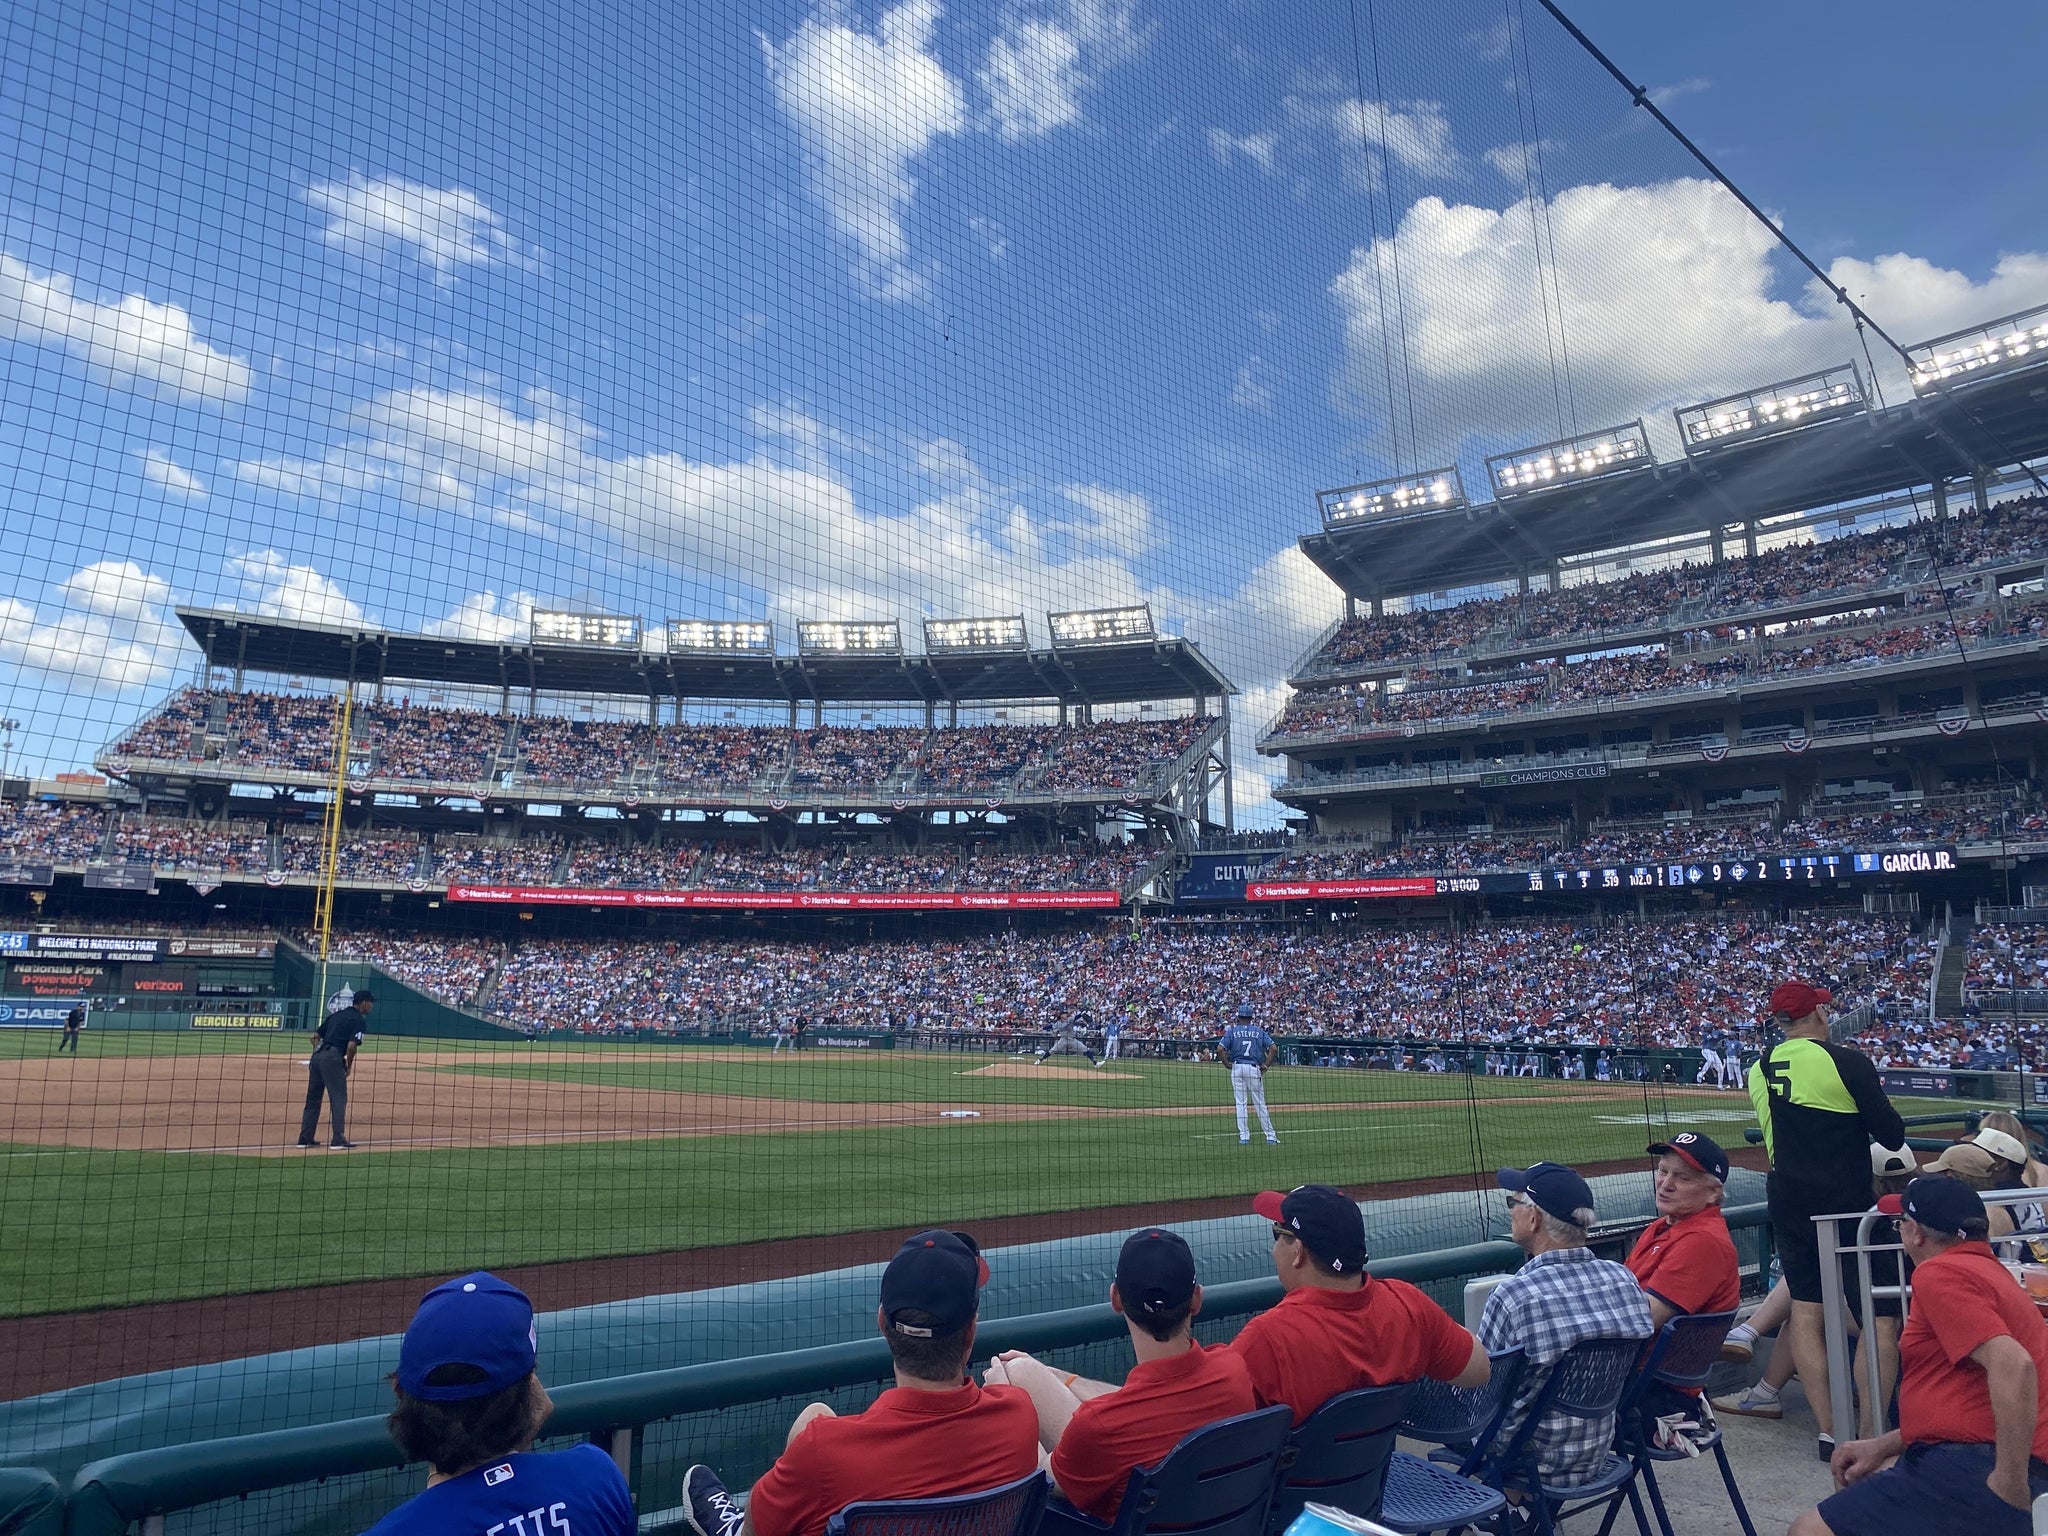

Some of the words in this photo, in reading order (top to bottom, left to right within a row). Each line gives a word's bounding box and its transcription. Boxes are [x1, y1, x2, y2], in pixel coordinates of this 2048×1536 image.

[1510, 769, 1574, 783] CHAMPIONS
[1577, 766, 1607, 778] CLUB
[1882, 850, 1932, 872] GARCÍA
[1934, 851, 1956, 869] JR.
[1713, 865, 1721, 881] 9
[1759, 862, 1766, 878] 2
[1786, 867, 1792, 879] 3
[1806, 866, 1813, 878] 2
[1829, 865, 1834, 877] 1
[1436, 880, 1447, 892] 29
[1450, 879, 1479, 891] WOOD
[1529, 880, 1542, 890] .121
[1559, 879, 1563, 888] 1
[1581, 878, 1587, 888] 3
[1602, 876, 1619, 887] .519
[1629, 874, 1652, 886] 102.0
[38, 937, 77, 948] WELCOME
[78, 938, 89, 949] TO
[90, 938, 134, 950] NATIONALS
[136, 940, 158, 951] PARK
[14, 964, 72, 974] Nationals
[75, 965, 103, 975] Park
[22, 975, 77, 984] powered
[78, 975, 94, 987] by
[135, 980, 183, 991] verizon
[34, 986, 79, 995] Verizon
[194, 1016, 245, 1027] HERCULES
[248, 1017, 279, 1027] FENCE
[828, 1037, 857, 1047] Washington
[858, 1039, 870, 1047] Post
[1242, 1041, 1251, 1056] 7
[1768, 1061, 1792, 1102] 5
